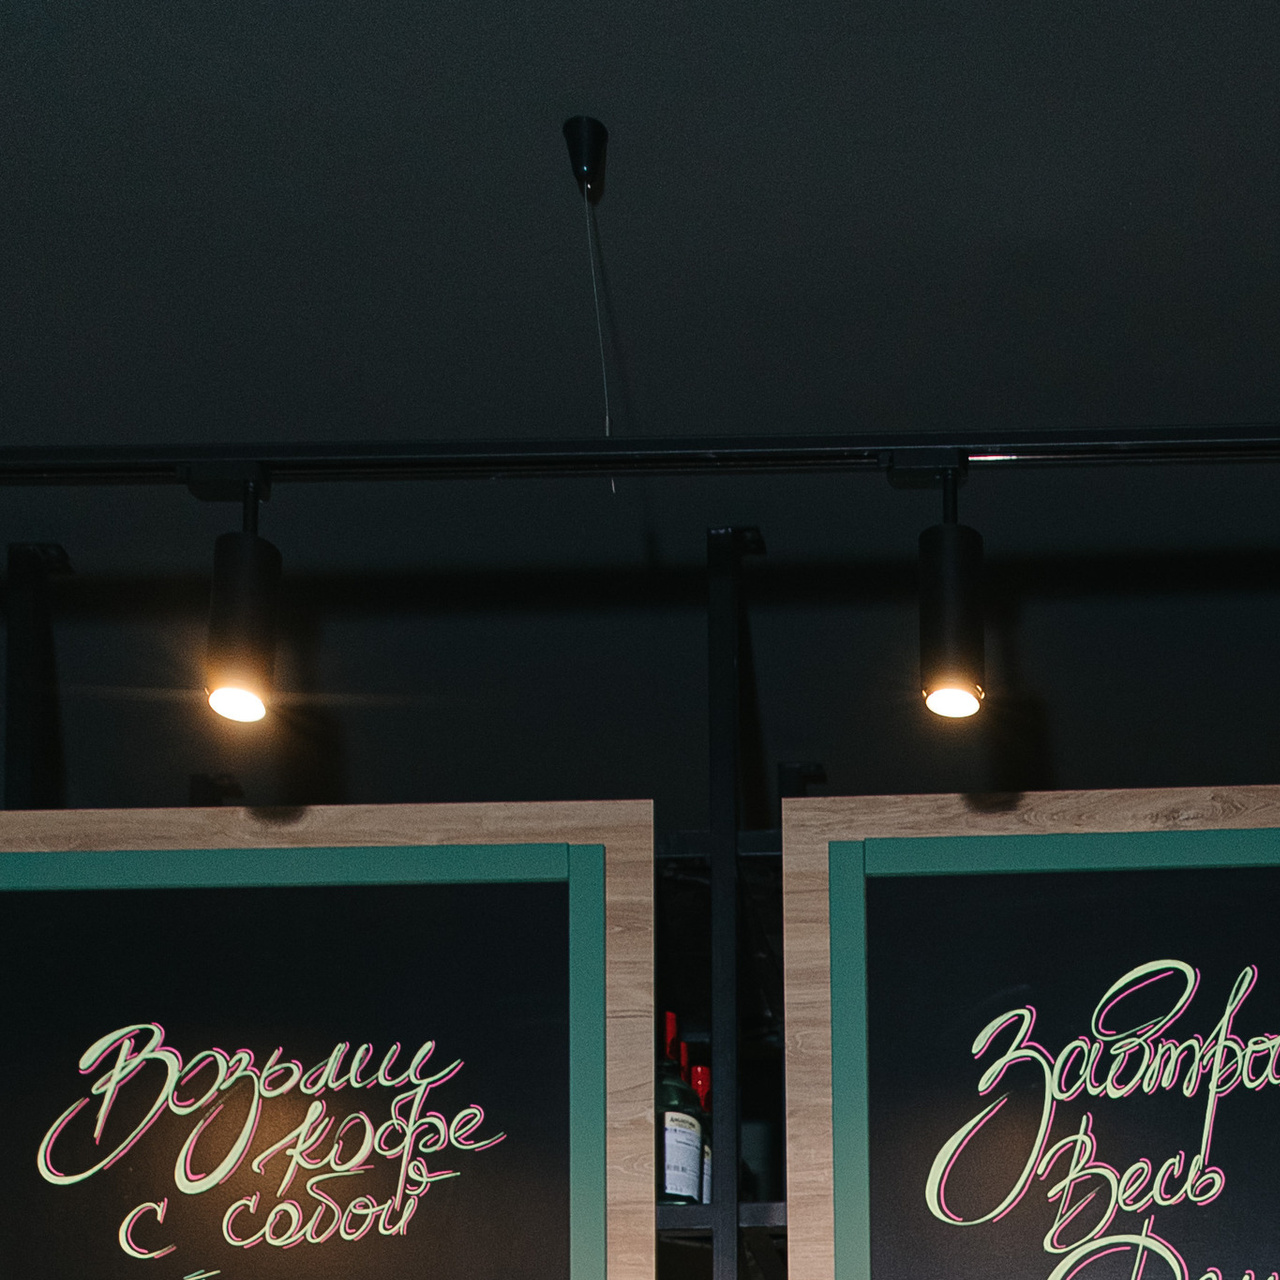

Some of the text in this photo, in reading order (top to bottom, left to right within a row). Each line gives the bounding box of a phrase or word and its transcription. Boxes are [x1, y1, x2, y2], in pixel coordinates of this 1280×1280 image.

[37, 1022, 465, 1194] Возьми
[222, 1156, 462, 1249] собой
[1036, 1111, 1226, 1254] Весь
